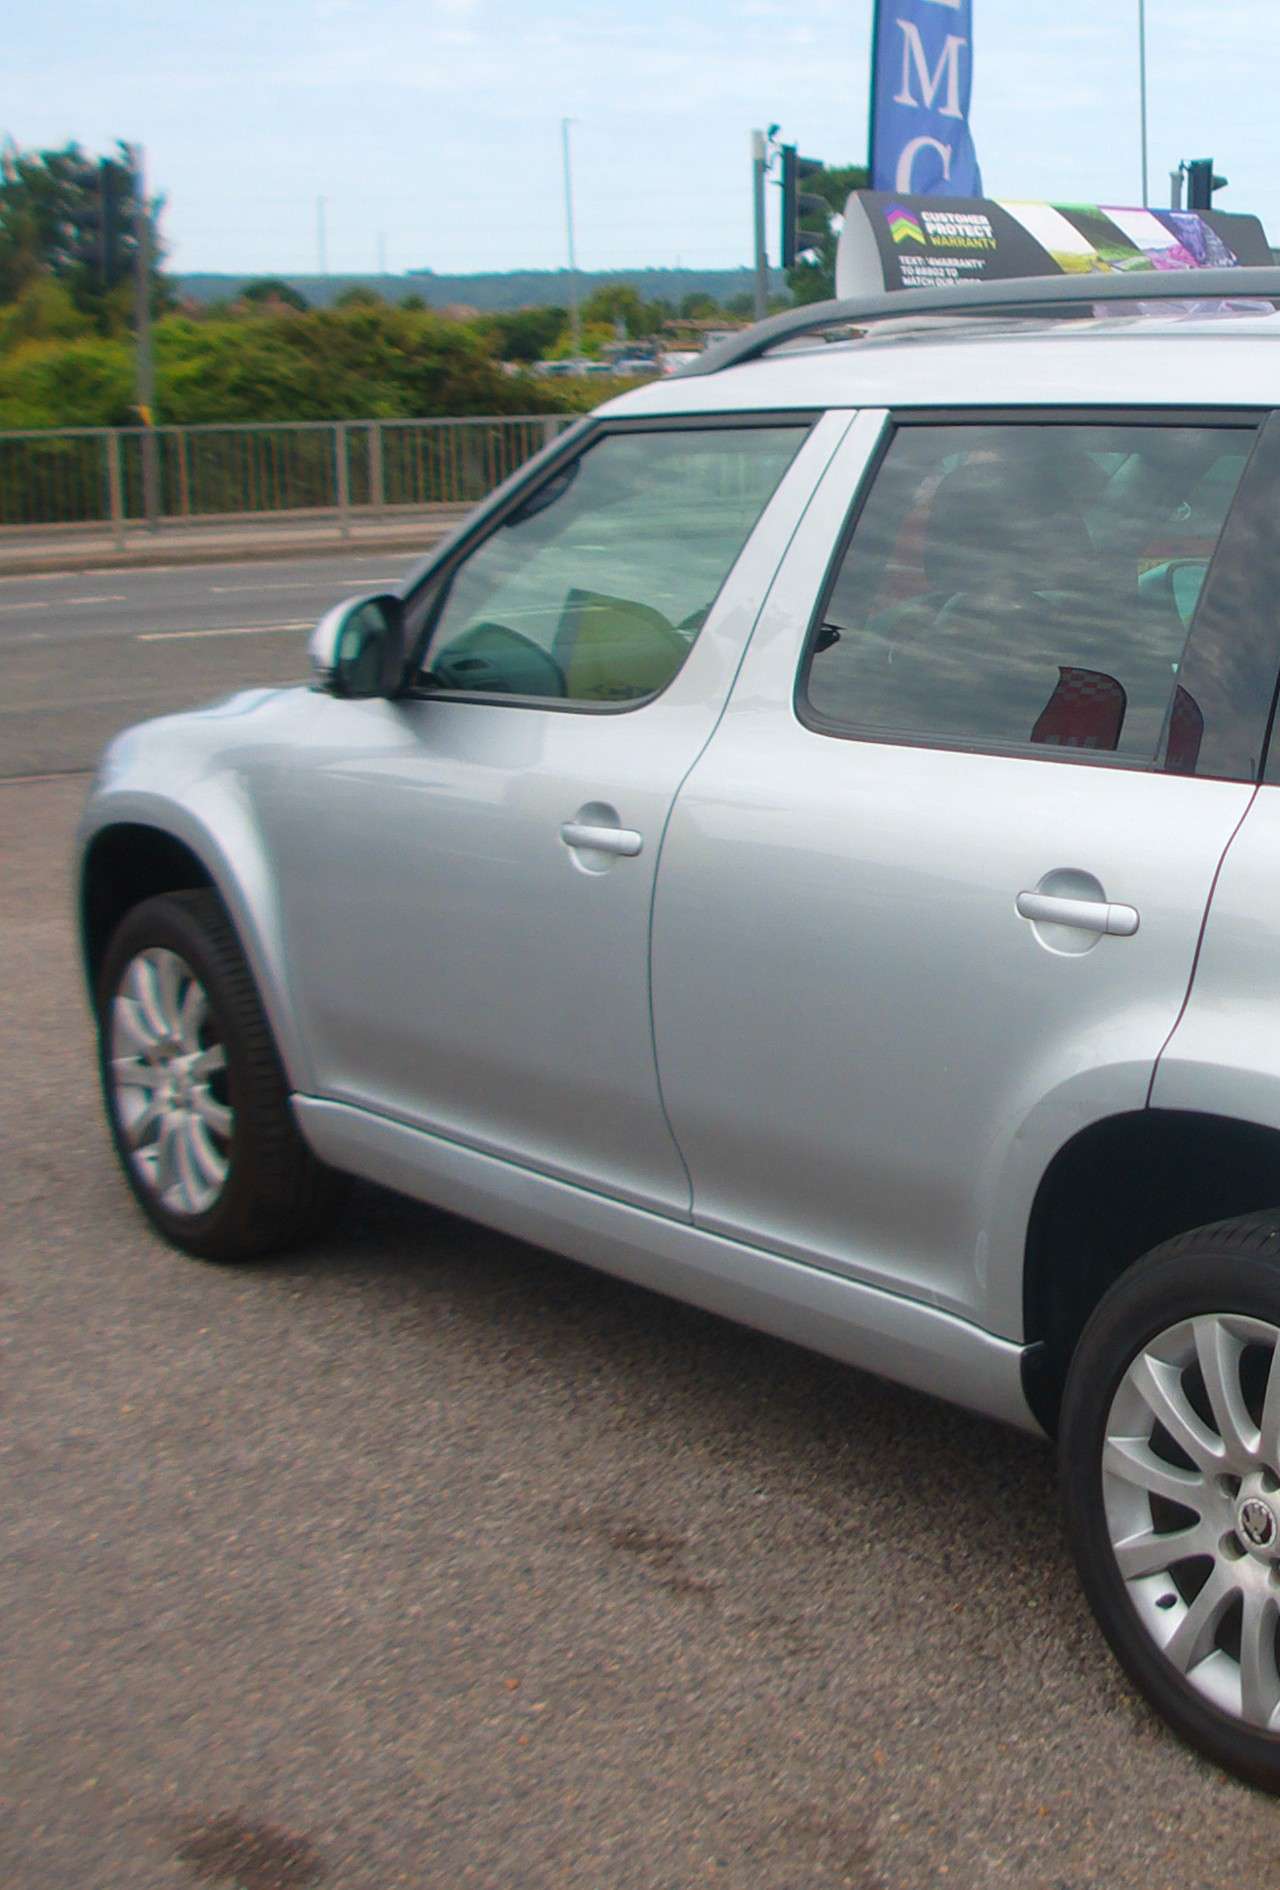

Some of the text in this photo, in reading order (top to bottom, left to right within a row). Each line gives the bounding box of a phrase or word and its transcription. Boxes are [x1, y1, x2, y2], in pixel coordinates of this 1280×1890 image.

[893, 0, 967, 194] MC
[921, 211, 990, 226] CUSTOMER
[925, 222, 994, 238] PROTECT
[930, 235, 997, 250] WARRANTY
